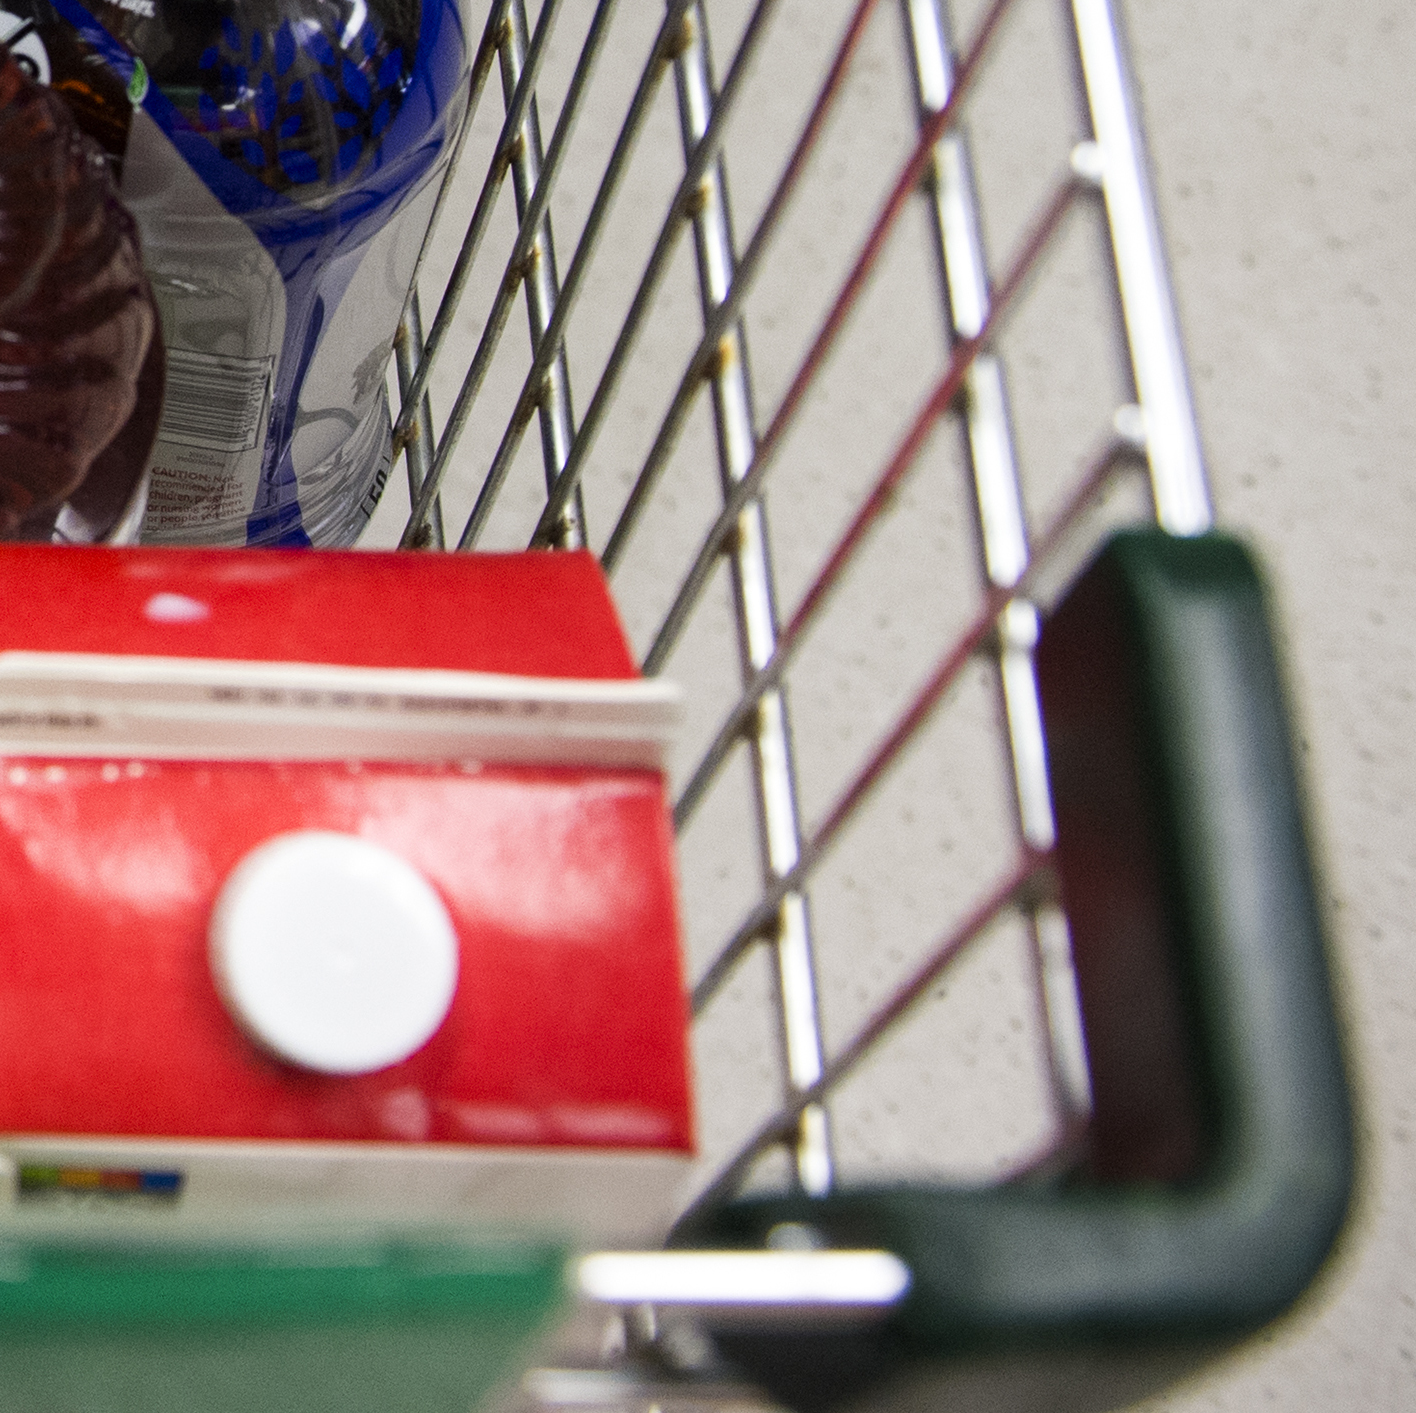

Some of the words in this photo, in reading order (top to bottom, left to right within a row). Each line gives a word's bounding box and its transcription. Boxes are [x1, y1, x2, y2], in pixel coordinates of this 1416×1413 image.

[152, 466, 211, 482] CAUTION:
[214, 475, 235, 483] Not
[151, 478, 224, 493] recommended
[149, 489, 193, 504] children,
[194, 490, 243, 505] pregnant
[148, 503, 160, 513] or
[161, 503, 199, 515] nursing
[202, 499, 242, 512] women
[160, 513, 197, 525] people
